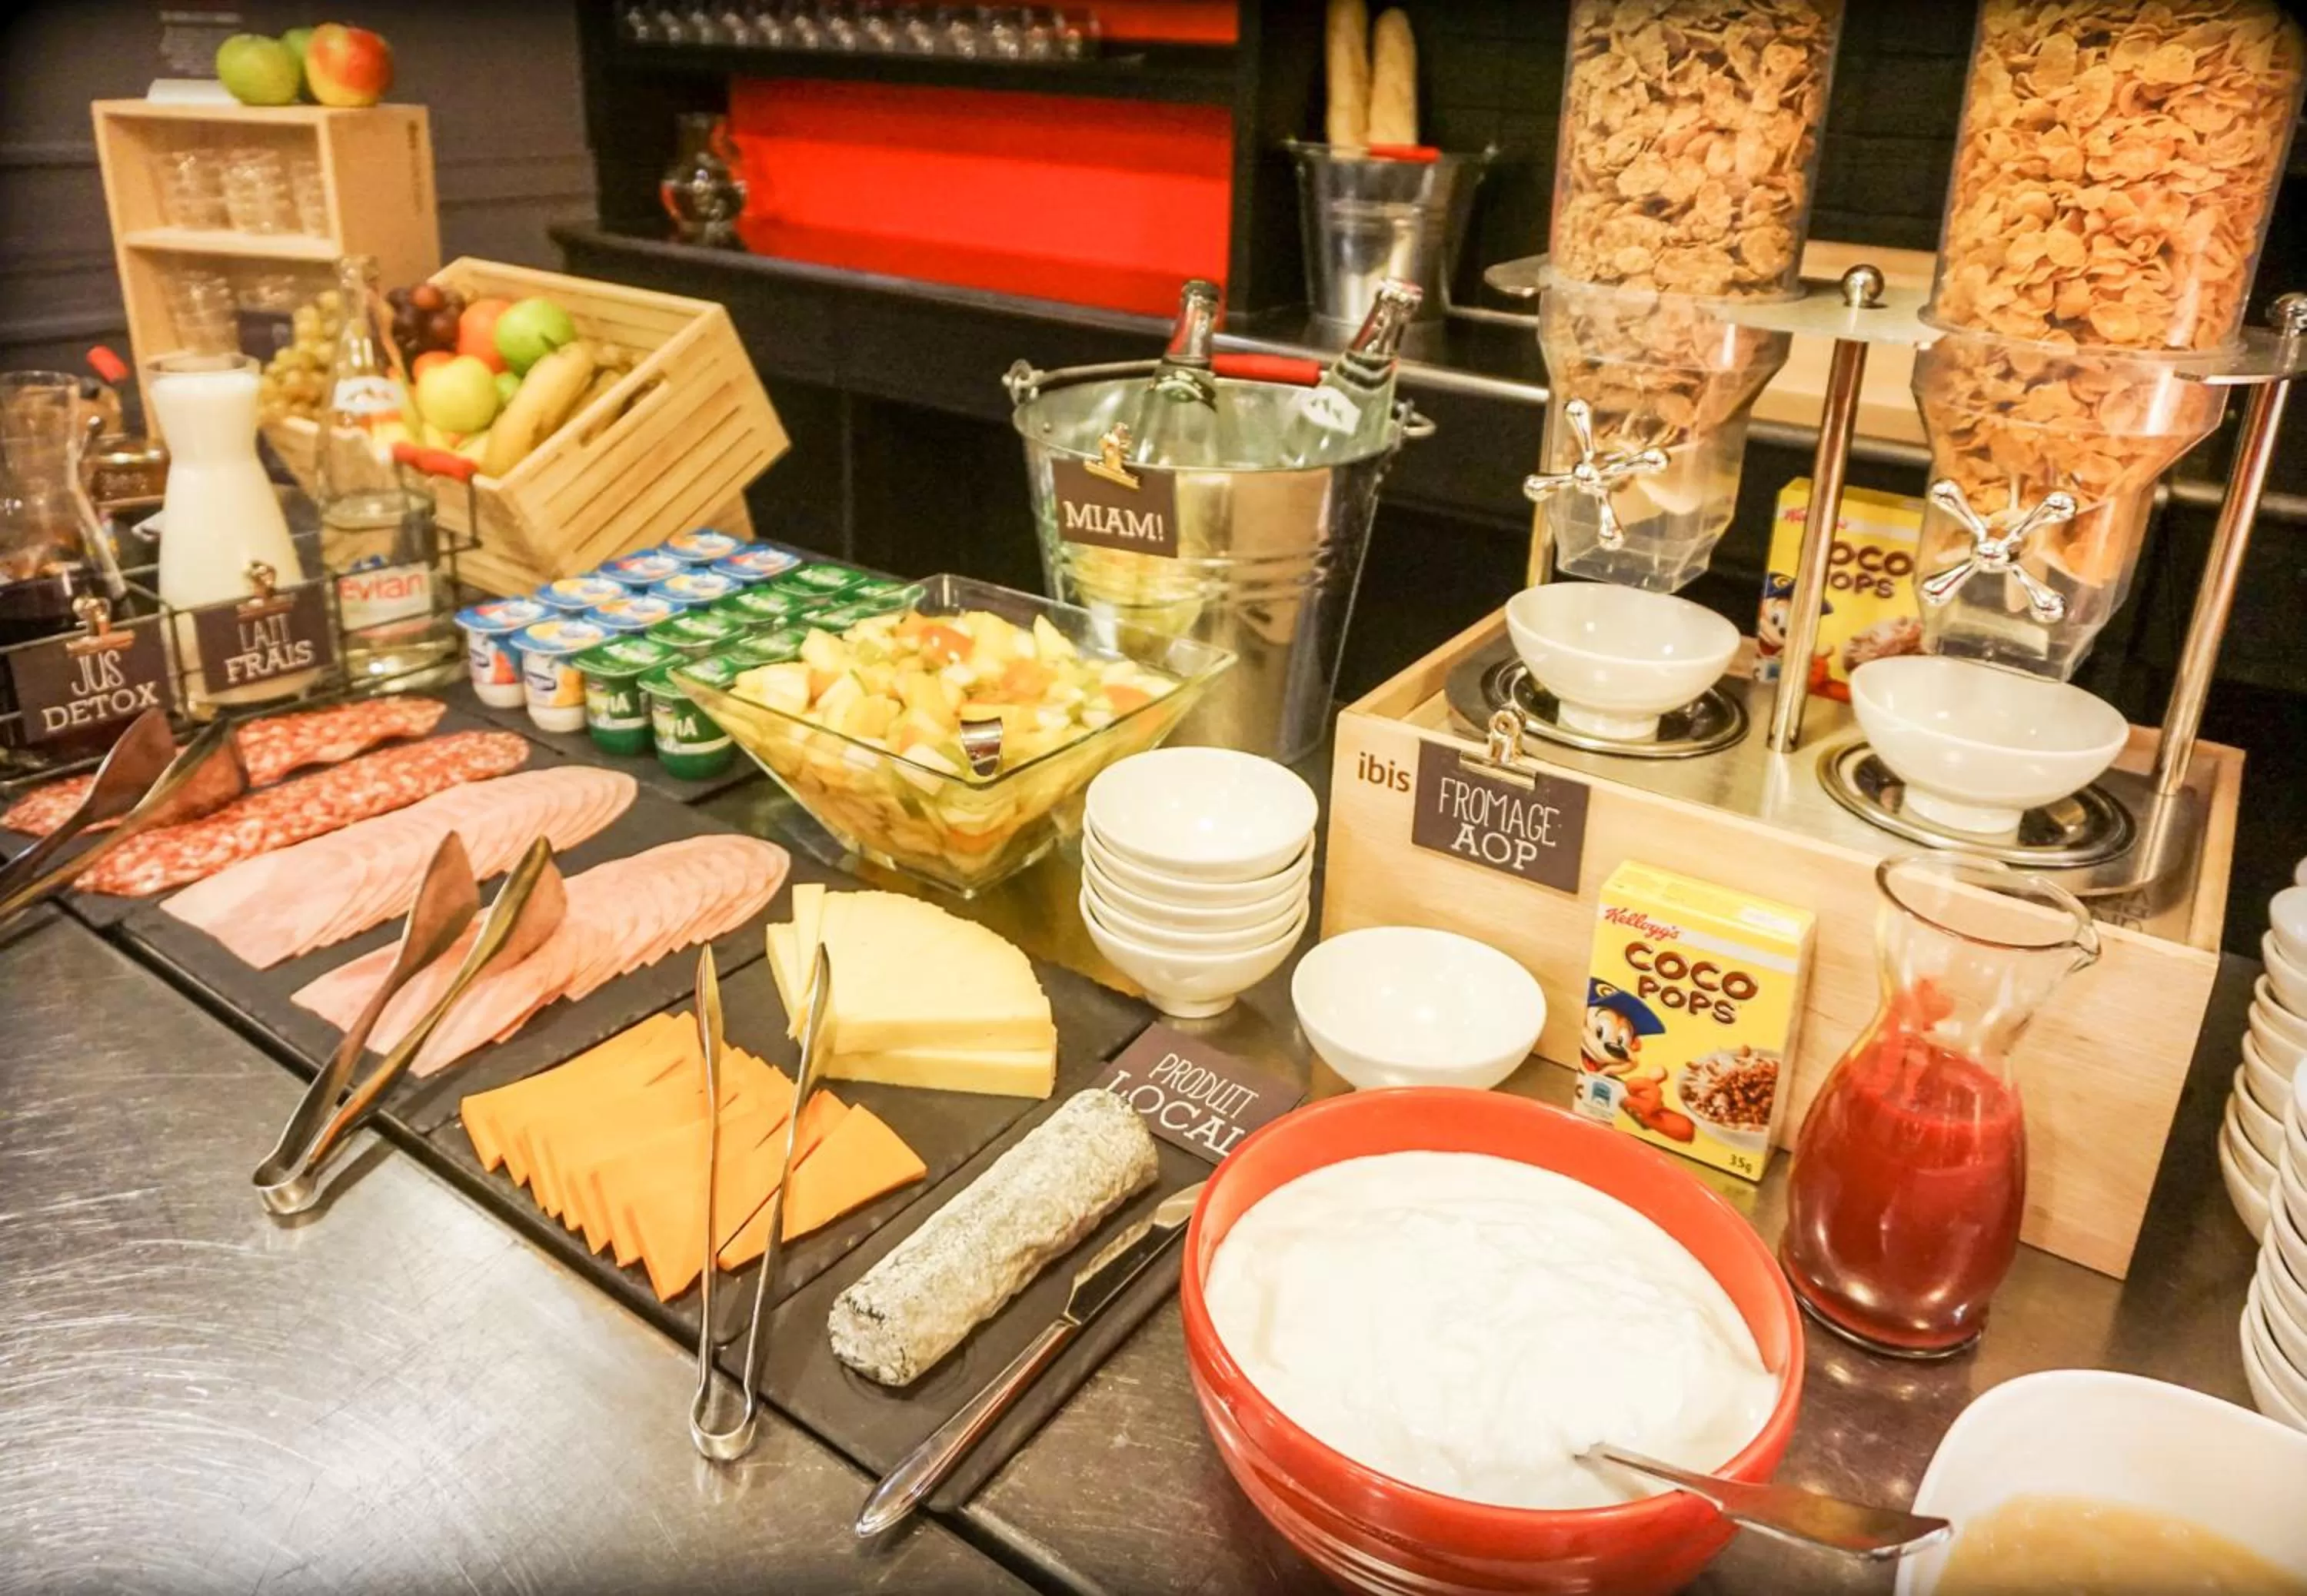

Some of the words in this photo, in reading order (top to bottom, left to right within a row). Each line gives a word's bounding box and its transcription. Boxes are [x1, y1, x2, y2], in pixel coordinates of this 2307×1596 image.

[1061, 500, 1164, 542] MIAM!
[1830, 540, 1915, 577] OCO
[335, 572, 425, 603] evian
[1829, 570, 1896, 600] OPS
[70, 650, 126, 697] JUS
[223, 639, 317, 685] FRAIS
[41, 680, 160, 733] DETOX
[1357, 751, 1411, 793] ibis
[1439, 776, 1560, 847] FROMAGE
[1451, 823, 1537, 871] AOP
[1604, 906, 1681, 942] Kellogg's
[1623, 940, 1759, 1001] COCO
[1636, 974, 1736, 1025] POPS
[1147, 1052, 1260, 1120] PRODUIT
[1105, 1069, 1246, 1158] LOCAL
[1728, 1153, 1753, 1175] 35g
